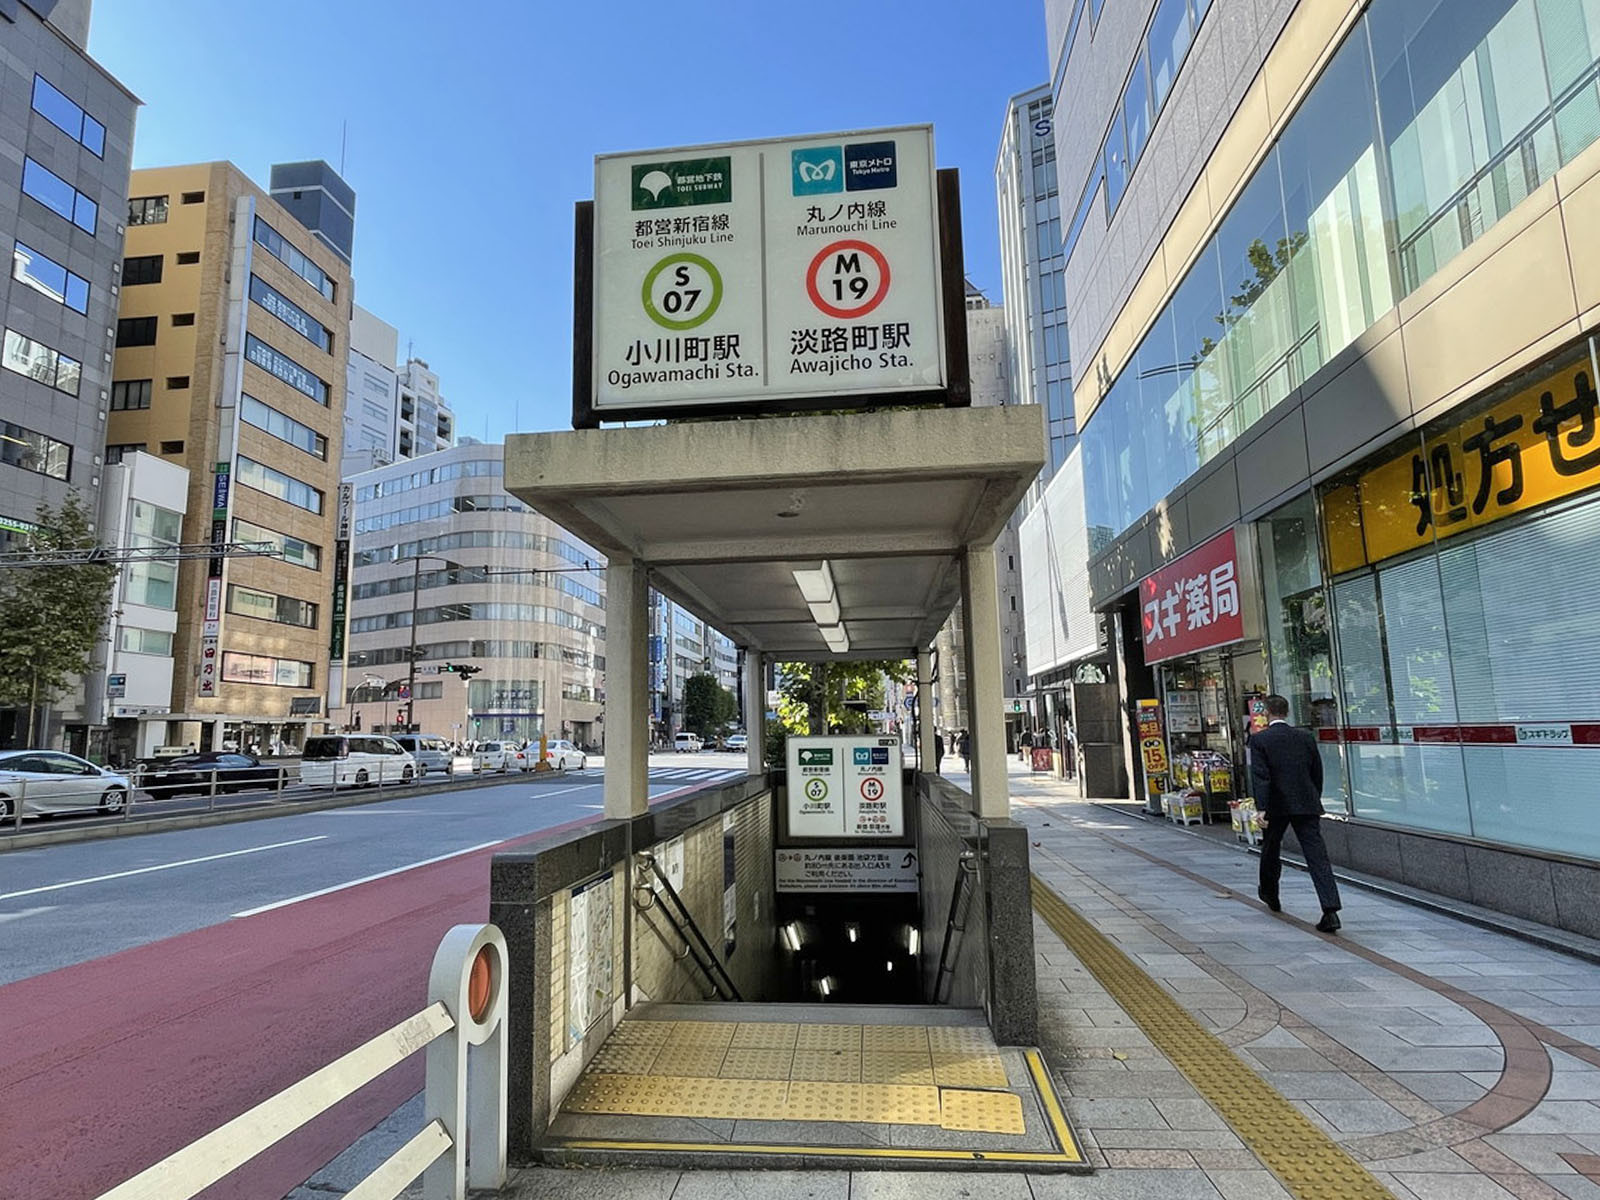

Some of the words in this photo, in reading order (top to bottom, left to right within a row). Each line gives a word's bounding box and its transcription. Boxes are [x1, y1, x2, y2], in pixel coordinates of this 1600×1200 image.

[849, 158, 892, 169] 東京メトロ
[852, 168, 870, 176] Tokyo
[677, 173, 723, 184] 都営地下鉄
[694, 182, 723, 191] SUBWAY
[806, 200, 887, 223] 丸ノ内線
[635, 213, 730, 237] 都営新宿線
[797, 220, 868, 236] Marunouchi
[872, 219, 897, 230] Line
[632, 238, 653, 249] Toei
[658, 234, 706, 248] Shinjuku
[710, 232, 734, 243] Line
[835, 252, 861, 275] M
[675, 266, 690, 287] S
[832, 276, 869, 301] 19
[663, 289, 702, 313] 07
[625, 334, 740, 366] 小川町駅
[790, 322, 911, 356] 淡路町駅
[608, 363, 719, 389] Ogawamachi
[726, 362, 759, 378] Sta.
[790, 353, 872, 376] Awajicho
[879, 352, 914, 368] Sta.
[1144, 560, 1239, 645] スギ薬局
[1144, 749, 1162, 763] 15
